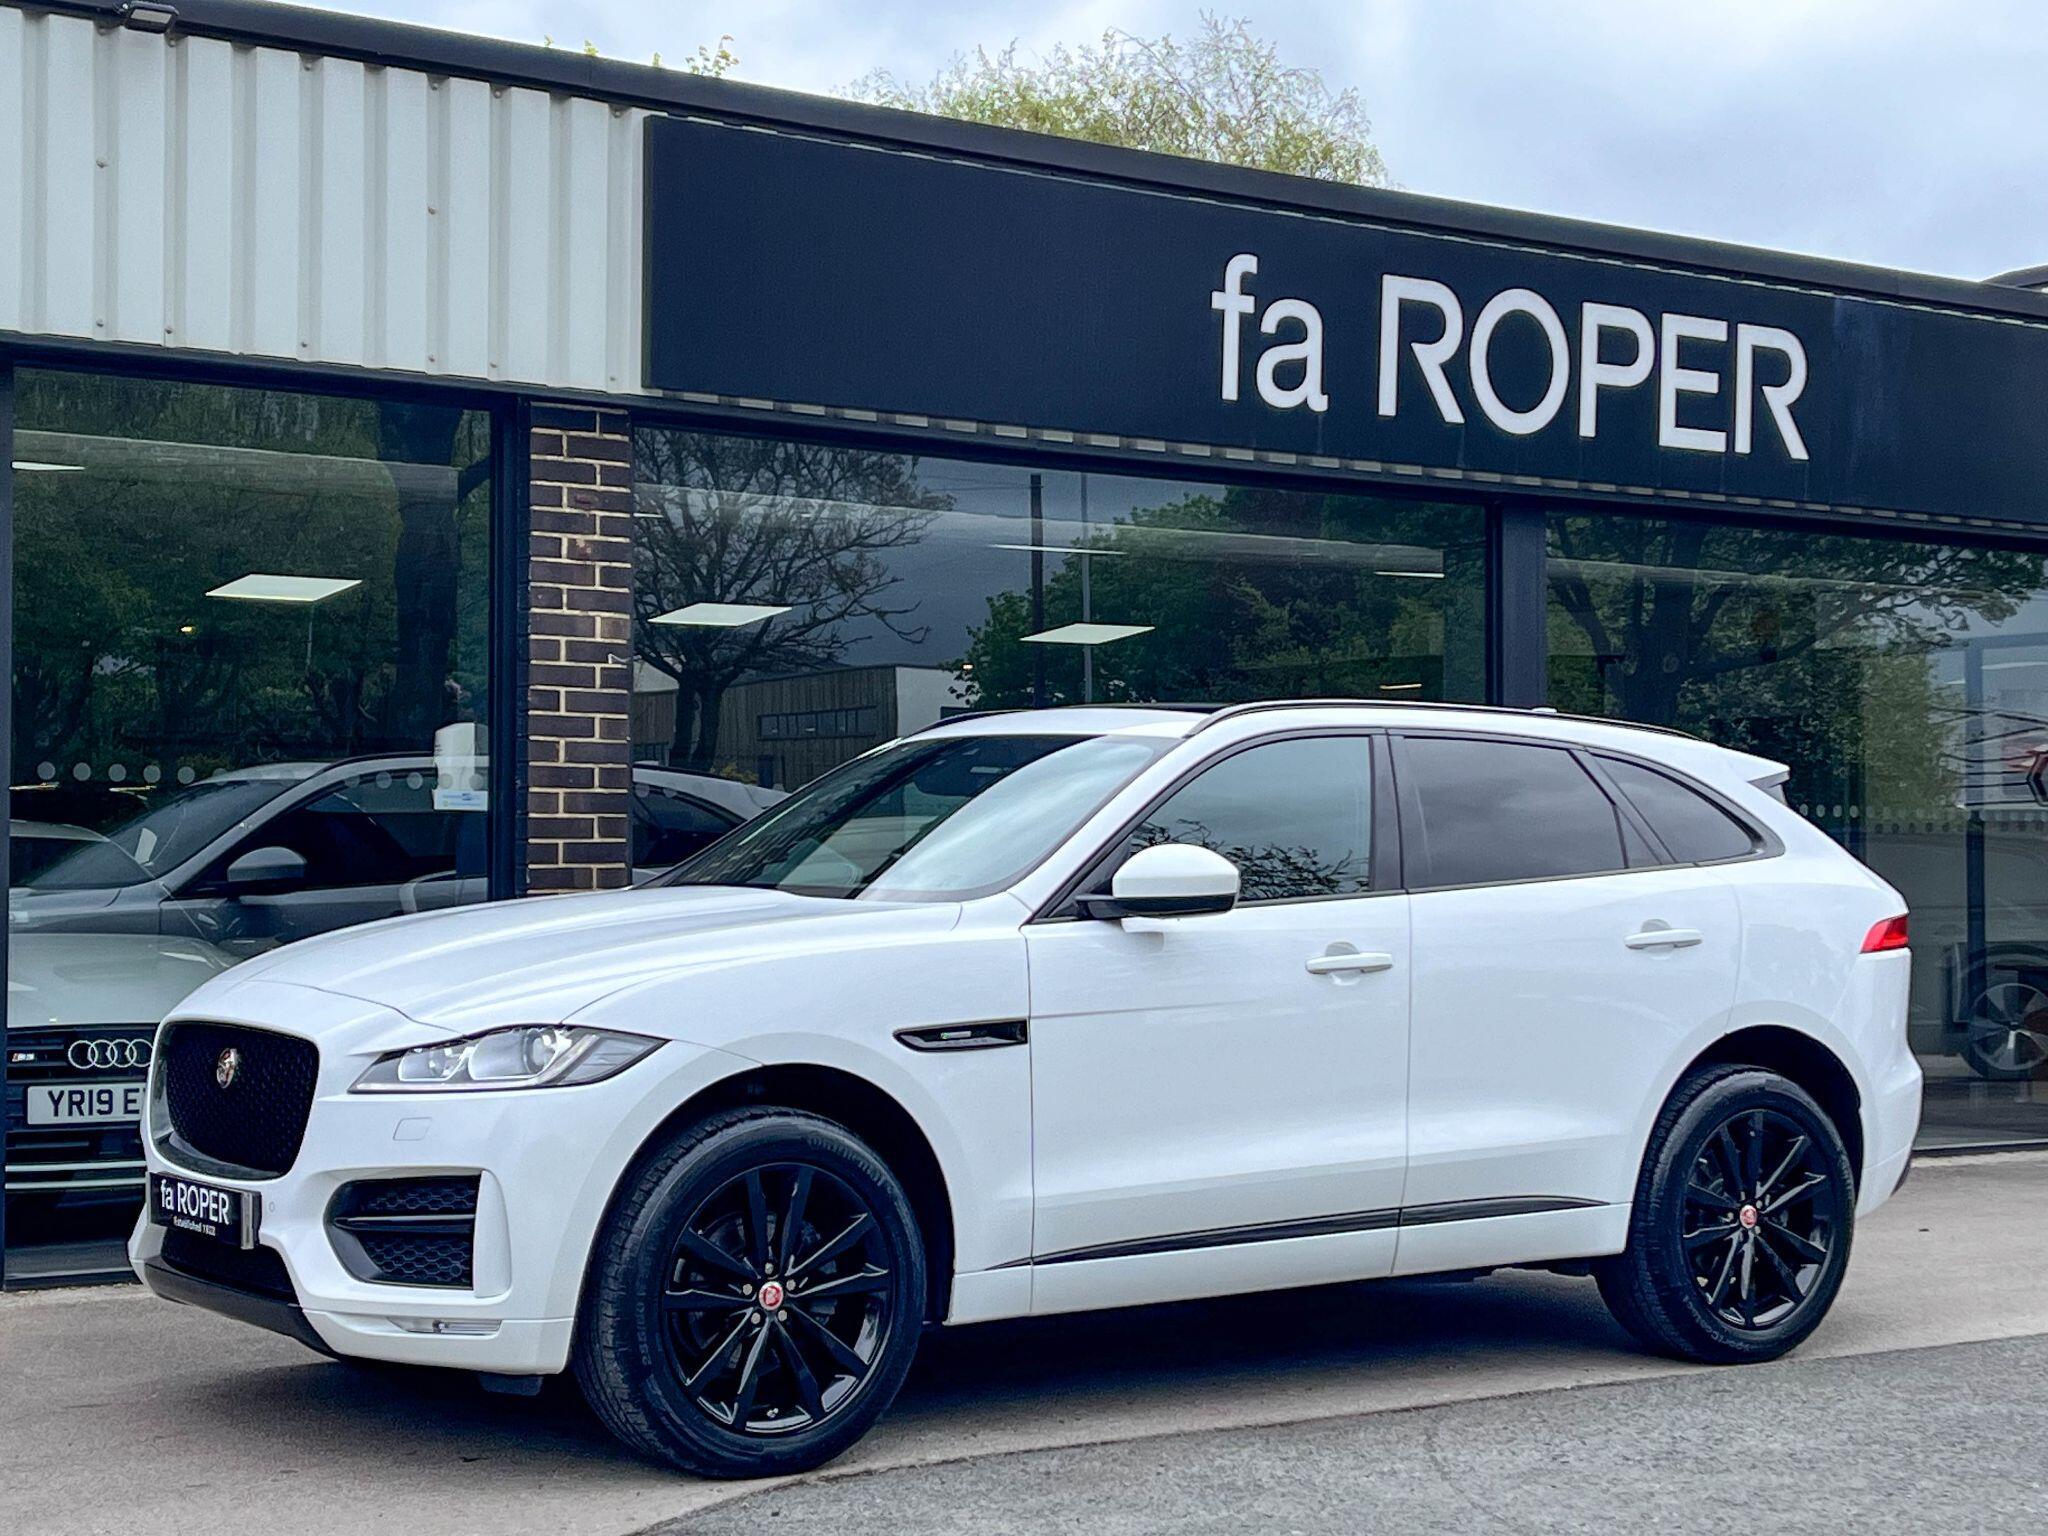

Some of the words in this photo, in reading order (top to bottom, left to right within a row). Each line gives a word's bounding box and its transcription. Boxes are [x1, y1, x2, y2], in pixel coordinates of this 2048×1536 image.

[1211, 254, 1328, 413] fa
[1377, 273, 1810, 460] ROPER
[48, 1088, 114, 1117] YR19
[123, 1087, 145, 1115] E
[160, 1179, 175, 1210] fa
[177, 1182, 230, 1225] ROPER
